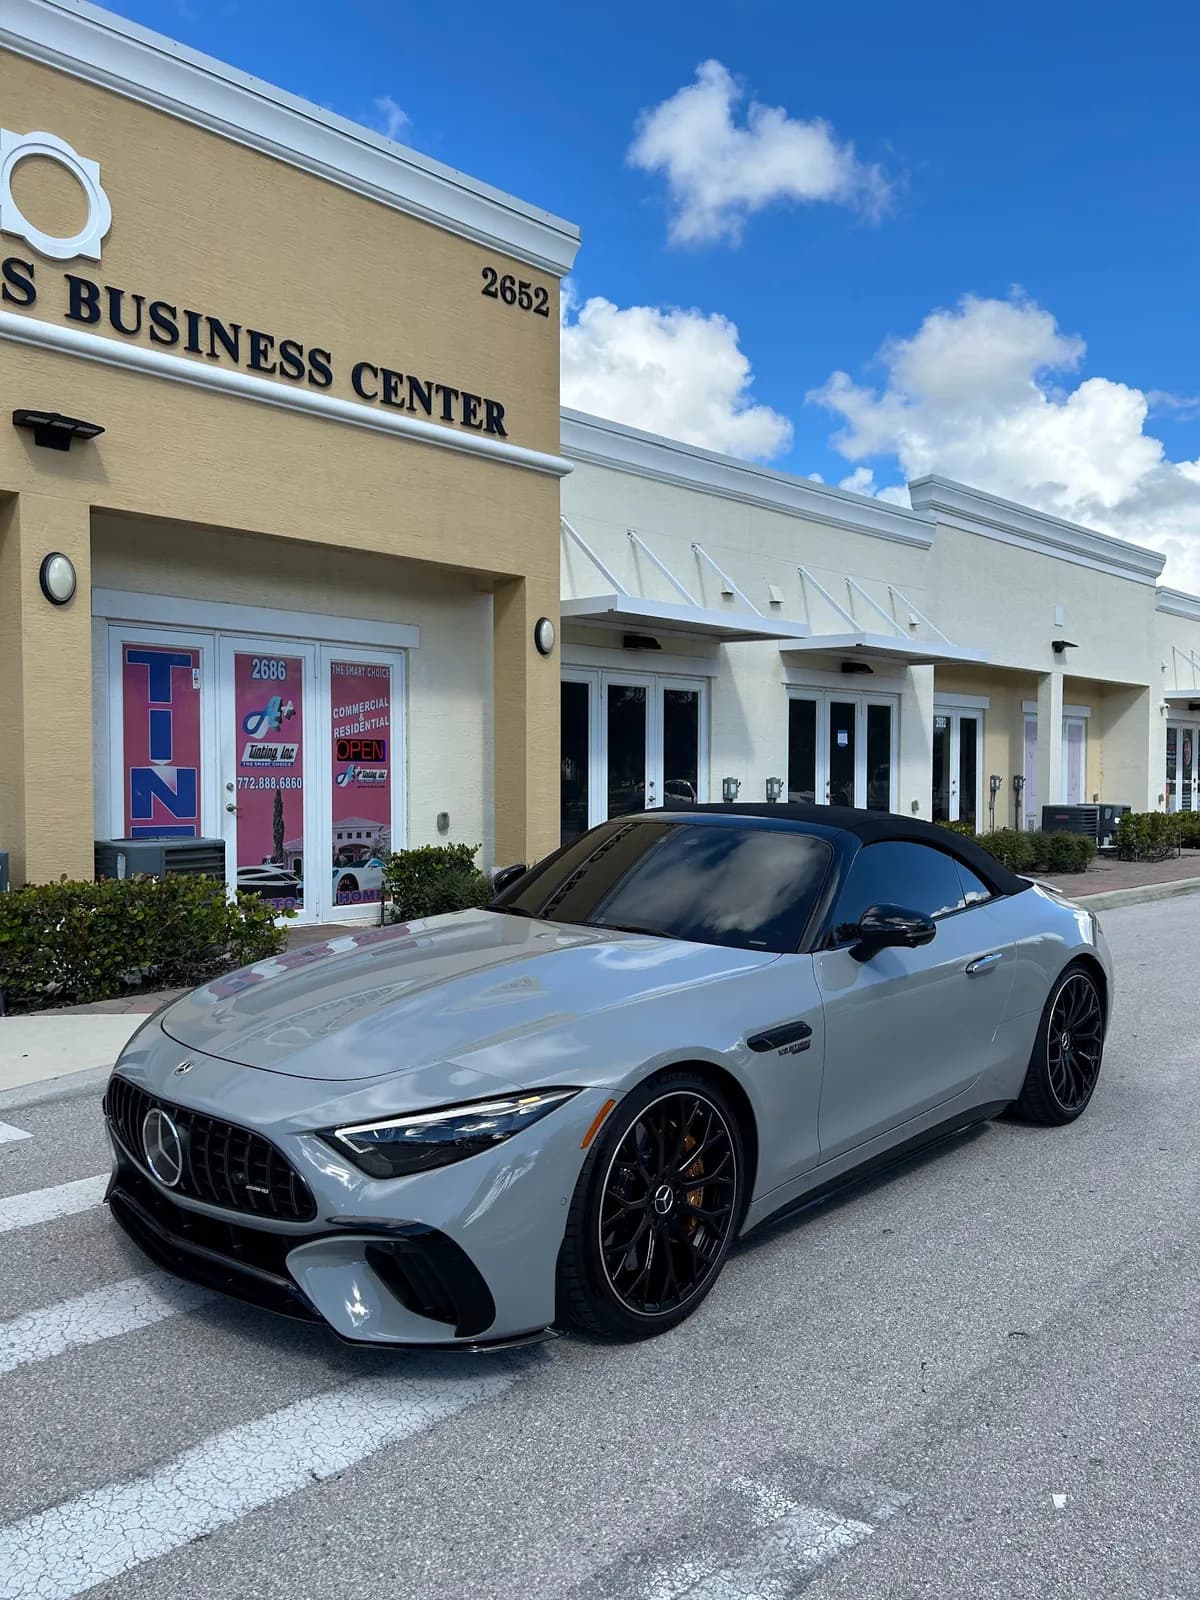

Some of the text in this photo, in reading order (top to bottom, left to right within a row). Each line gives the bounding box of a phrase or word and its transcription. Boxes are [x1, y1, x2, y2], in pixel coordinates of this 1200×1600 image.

[481, 266, 550, 318] 2652
[64, 273, 334, 389] BUSINESS
[351, 361, 508, 437] CENTER
[251, 658, 287, 681] 2686
[332, 664, 390, 679] THE SMART CHOICE
[332, 697, 390, 719] COMMERCIAL
[359, 712, 365, 722] &
[333, 715, 390, 739] RESIDENTIAL
[127, 650, 197, 838] TIN
[336, 740, 384, 760] OPEN
[237, 777, 303, 790] 772.888.6860
